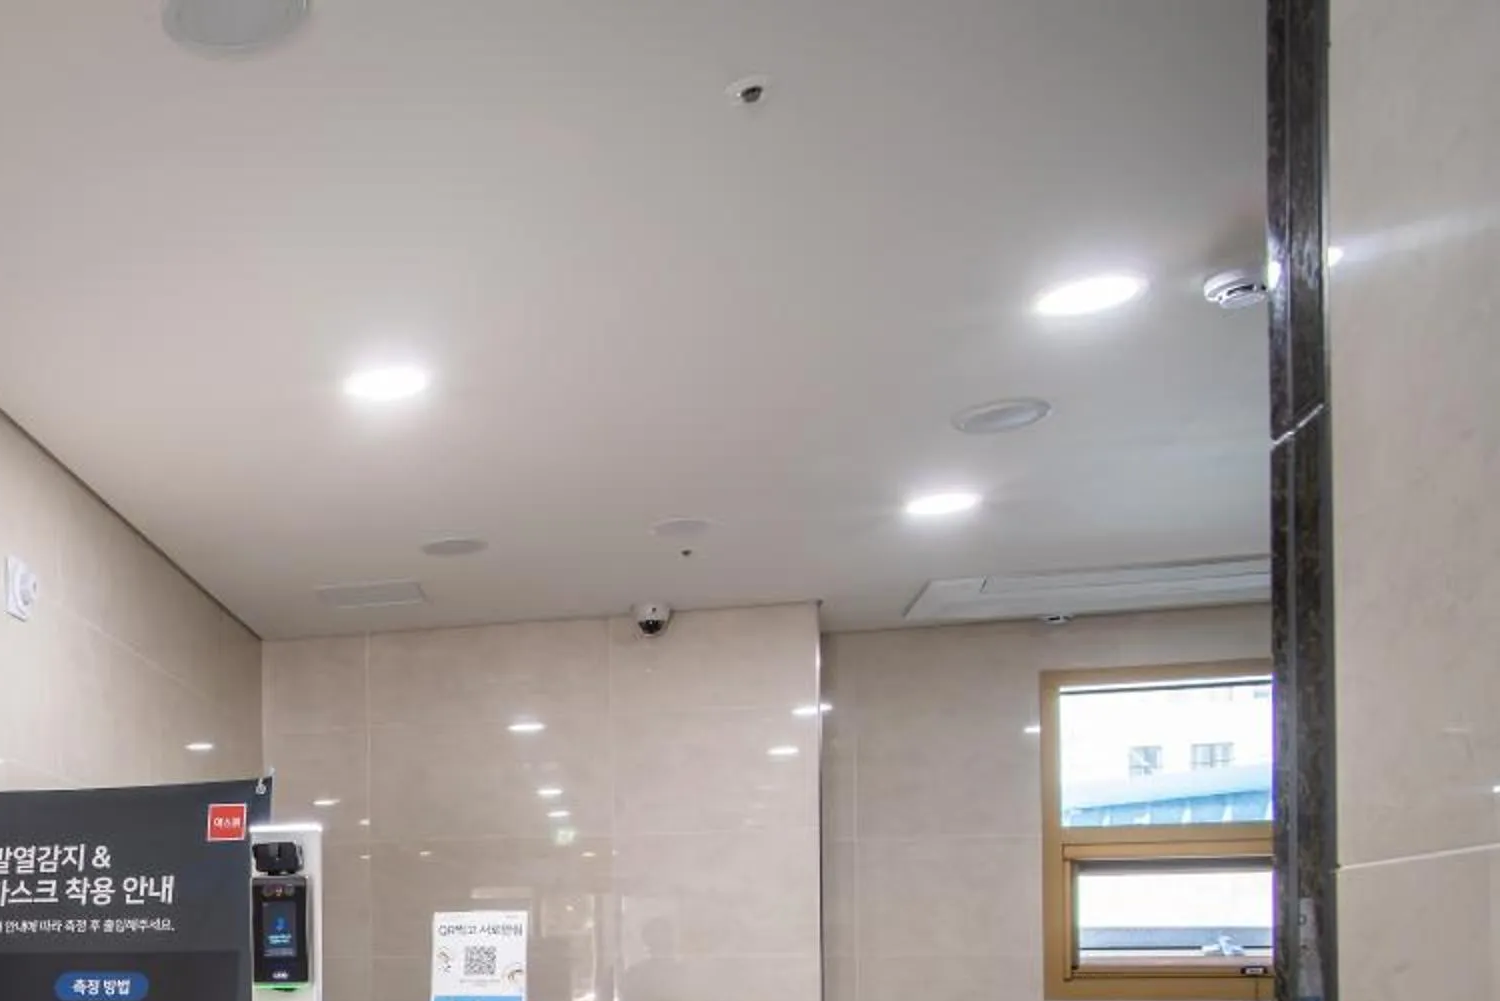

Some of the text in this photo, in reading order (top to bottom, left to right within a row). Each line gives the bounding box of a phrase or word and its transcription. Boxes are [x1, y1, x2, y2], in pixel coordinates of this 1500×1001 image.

[92, 845, 111, 869] &
[66, 876, 116, 906] 착용
[122, 875, 175, 904] 안내
[39, 919, 62, 933] 따라
[64, 918, 87, 933] 측정
[89, 919, 100, 932] 후
[72, 979, 131, 996] 측정 방법
